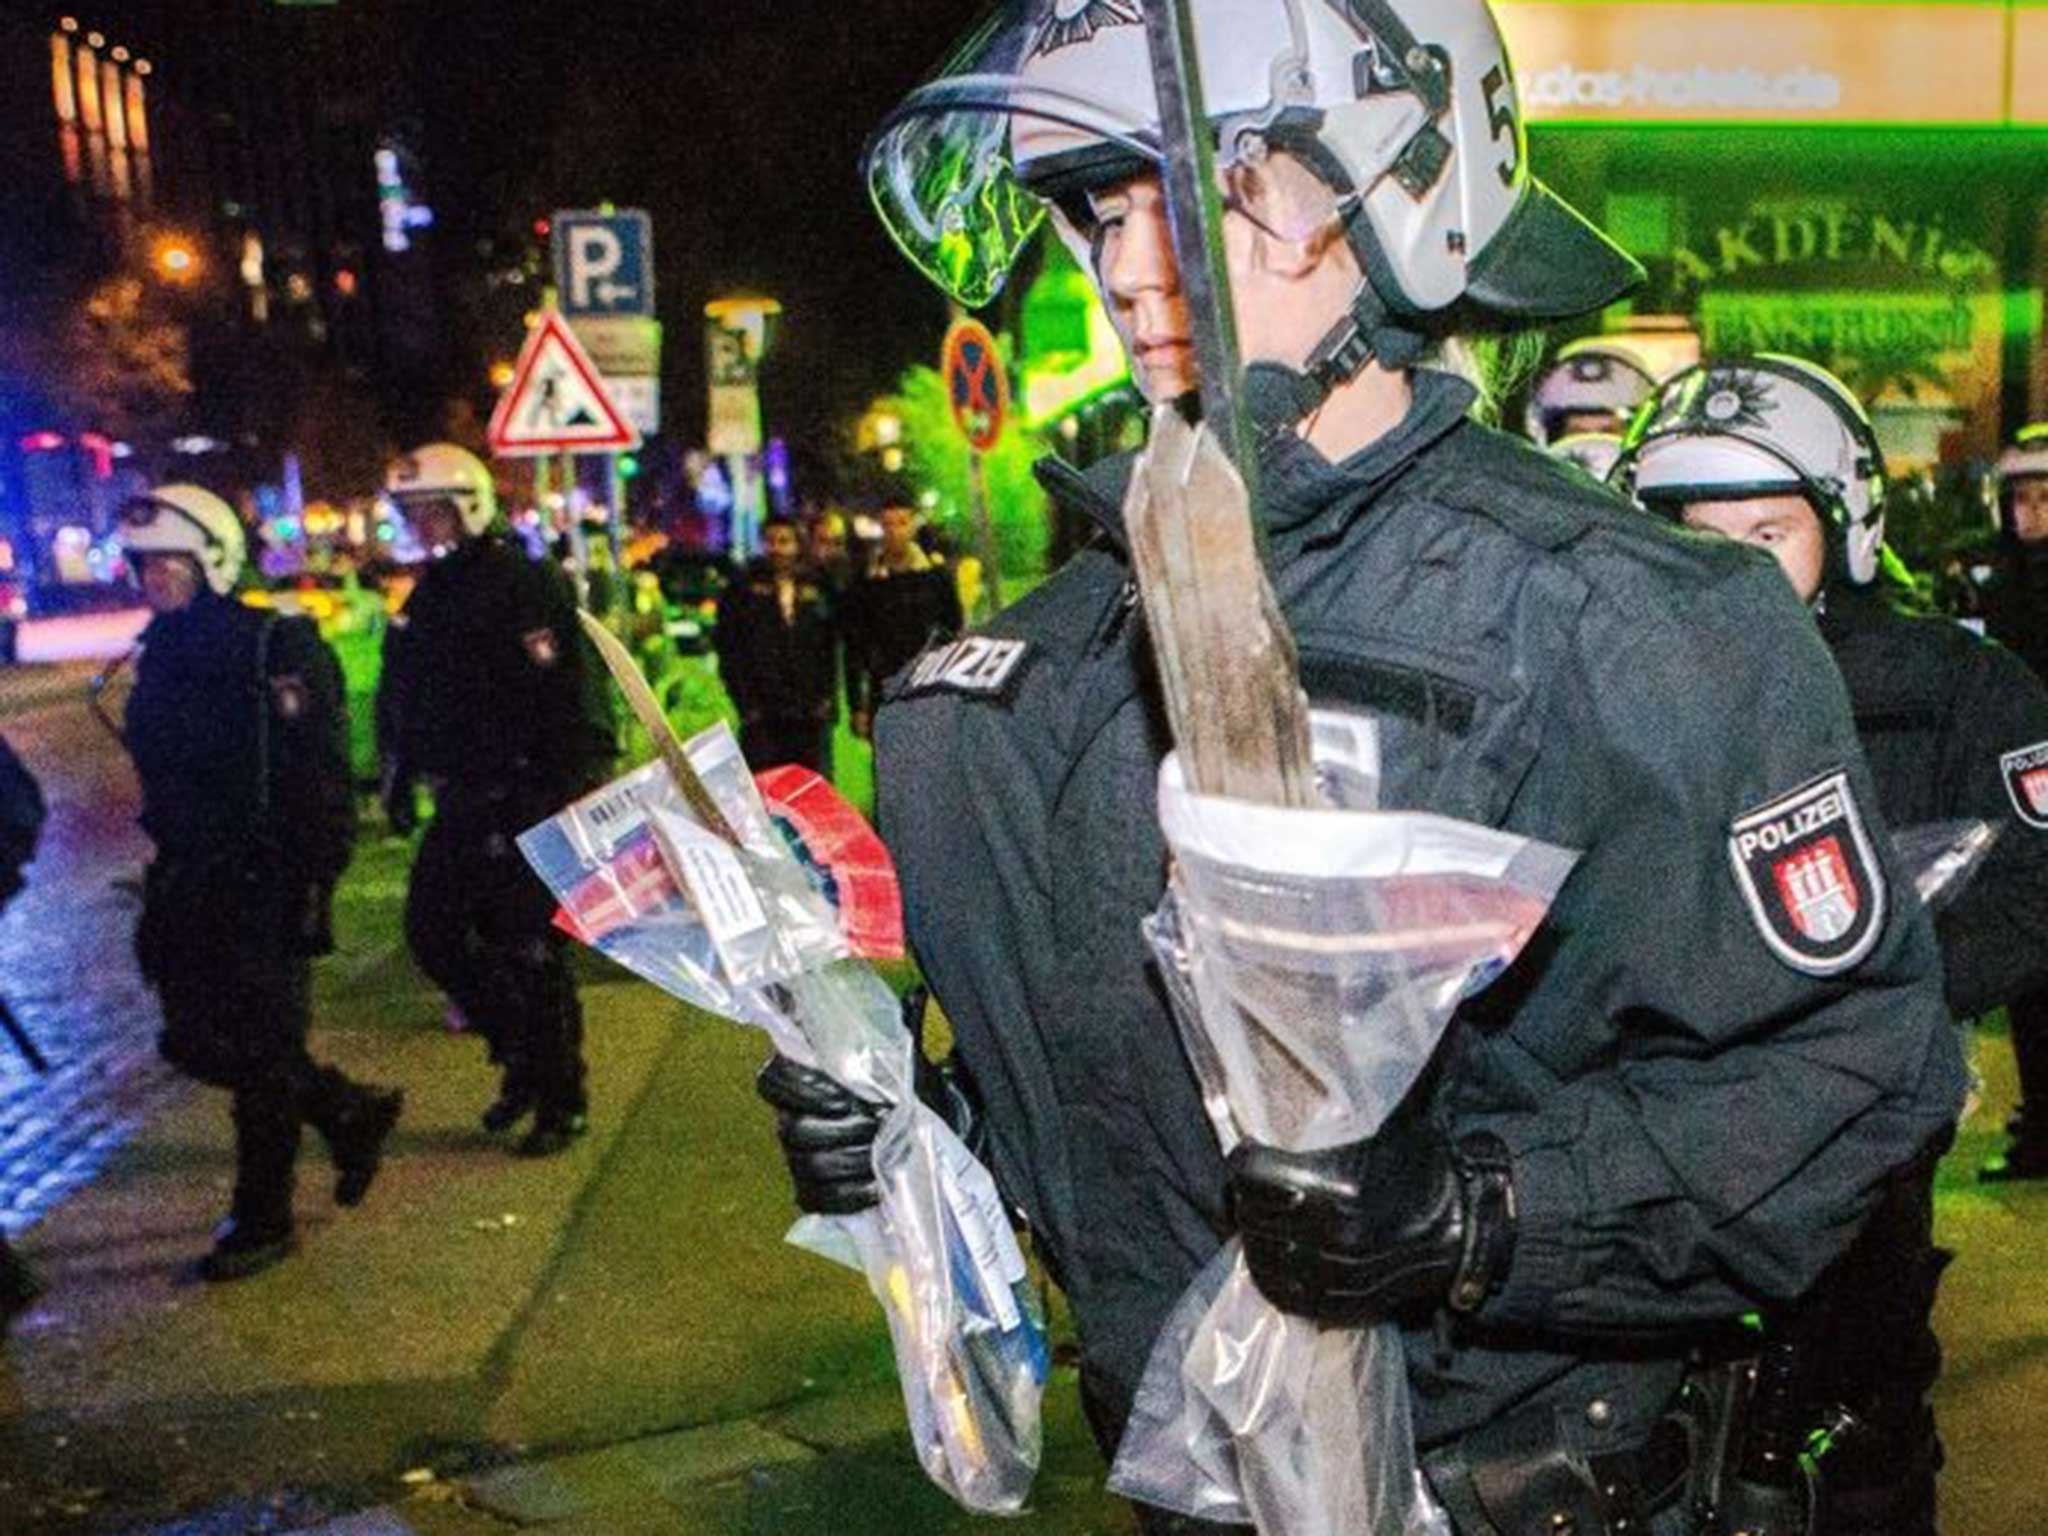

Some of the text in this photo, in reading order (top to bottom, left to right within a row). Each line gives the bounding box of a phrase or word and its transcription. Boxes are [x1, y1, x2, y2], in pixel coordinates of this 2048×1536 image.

[1481, 65, 1519, 188] 5
[570, 226, 621, 307] P
[1738, 792, 1846, 860] POLIZEI
